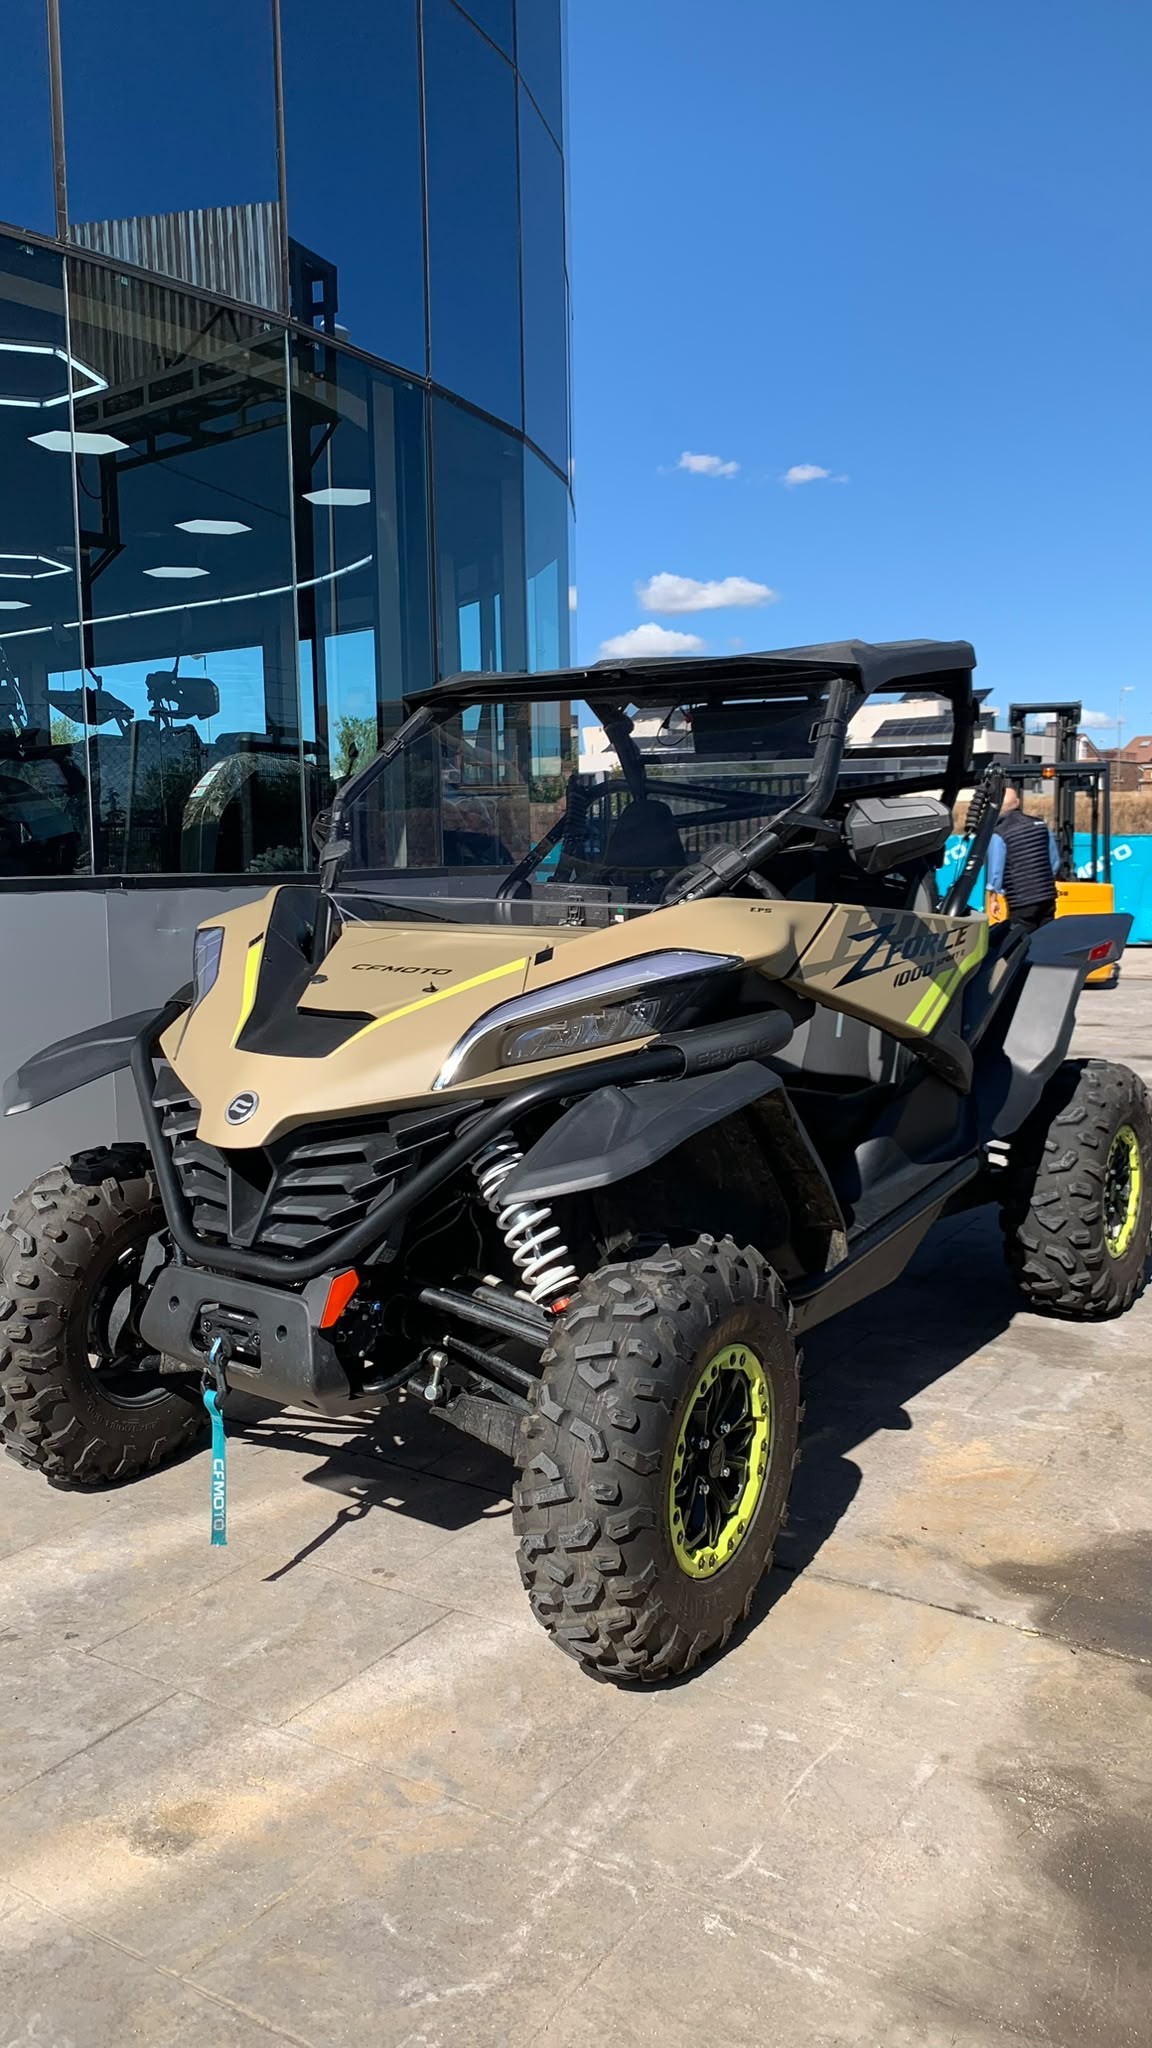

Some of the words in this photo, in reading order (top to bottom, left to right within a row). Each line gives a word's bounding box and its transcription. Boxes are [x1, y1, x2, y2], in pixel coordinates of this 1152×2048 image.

[351, 963, 453, 975] CFMOTO
[832, 923, 972, 989] ZFORCE
[893, 961, 934, 988] 1000
[213, 1458, 225, 1531] CFMOTO
